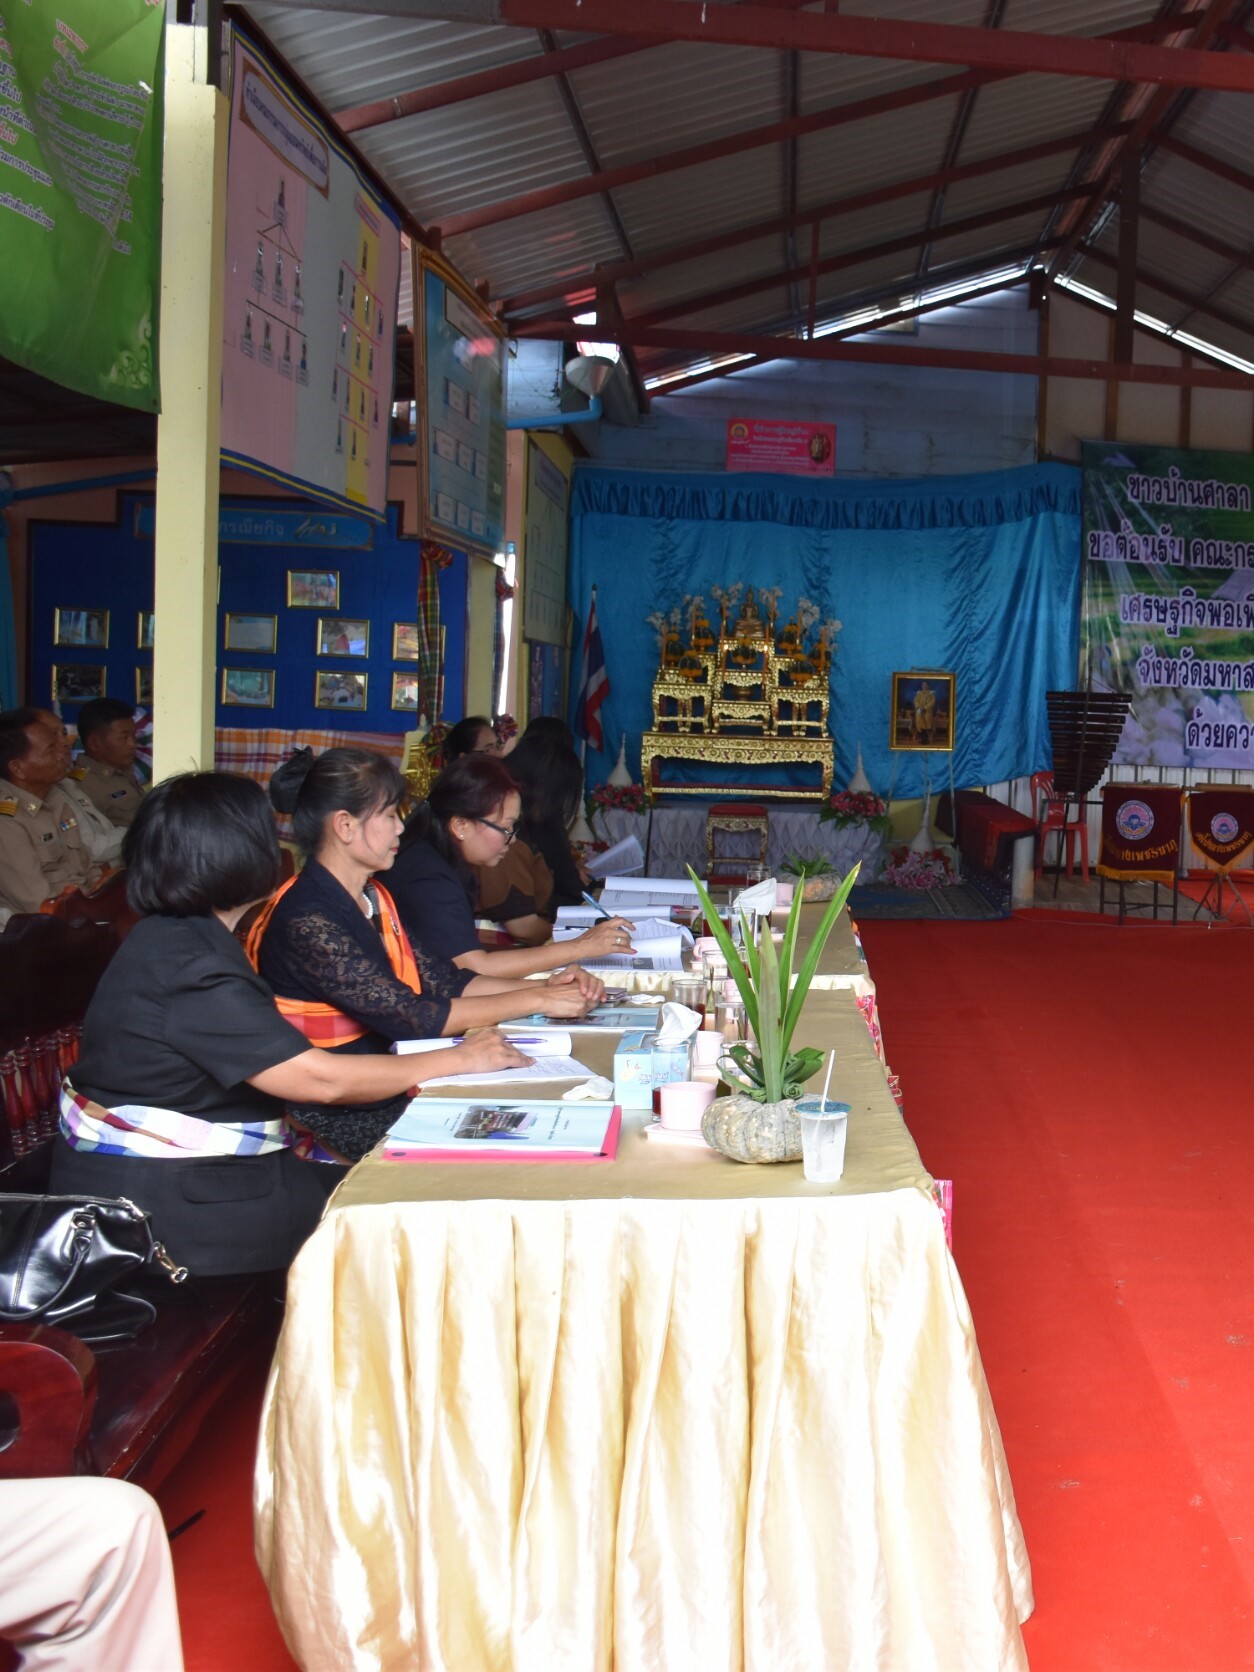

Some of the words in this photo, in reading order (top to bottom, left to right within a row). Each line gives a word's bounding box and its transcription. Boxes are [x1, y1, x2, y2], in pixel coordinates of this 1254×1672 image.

[1128, 467, 1250, 510] ชาวบ้านศาลา
[1088, 519, 1184, 566] ขอต้อนรับ
